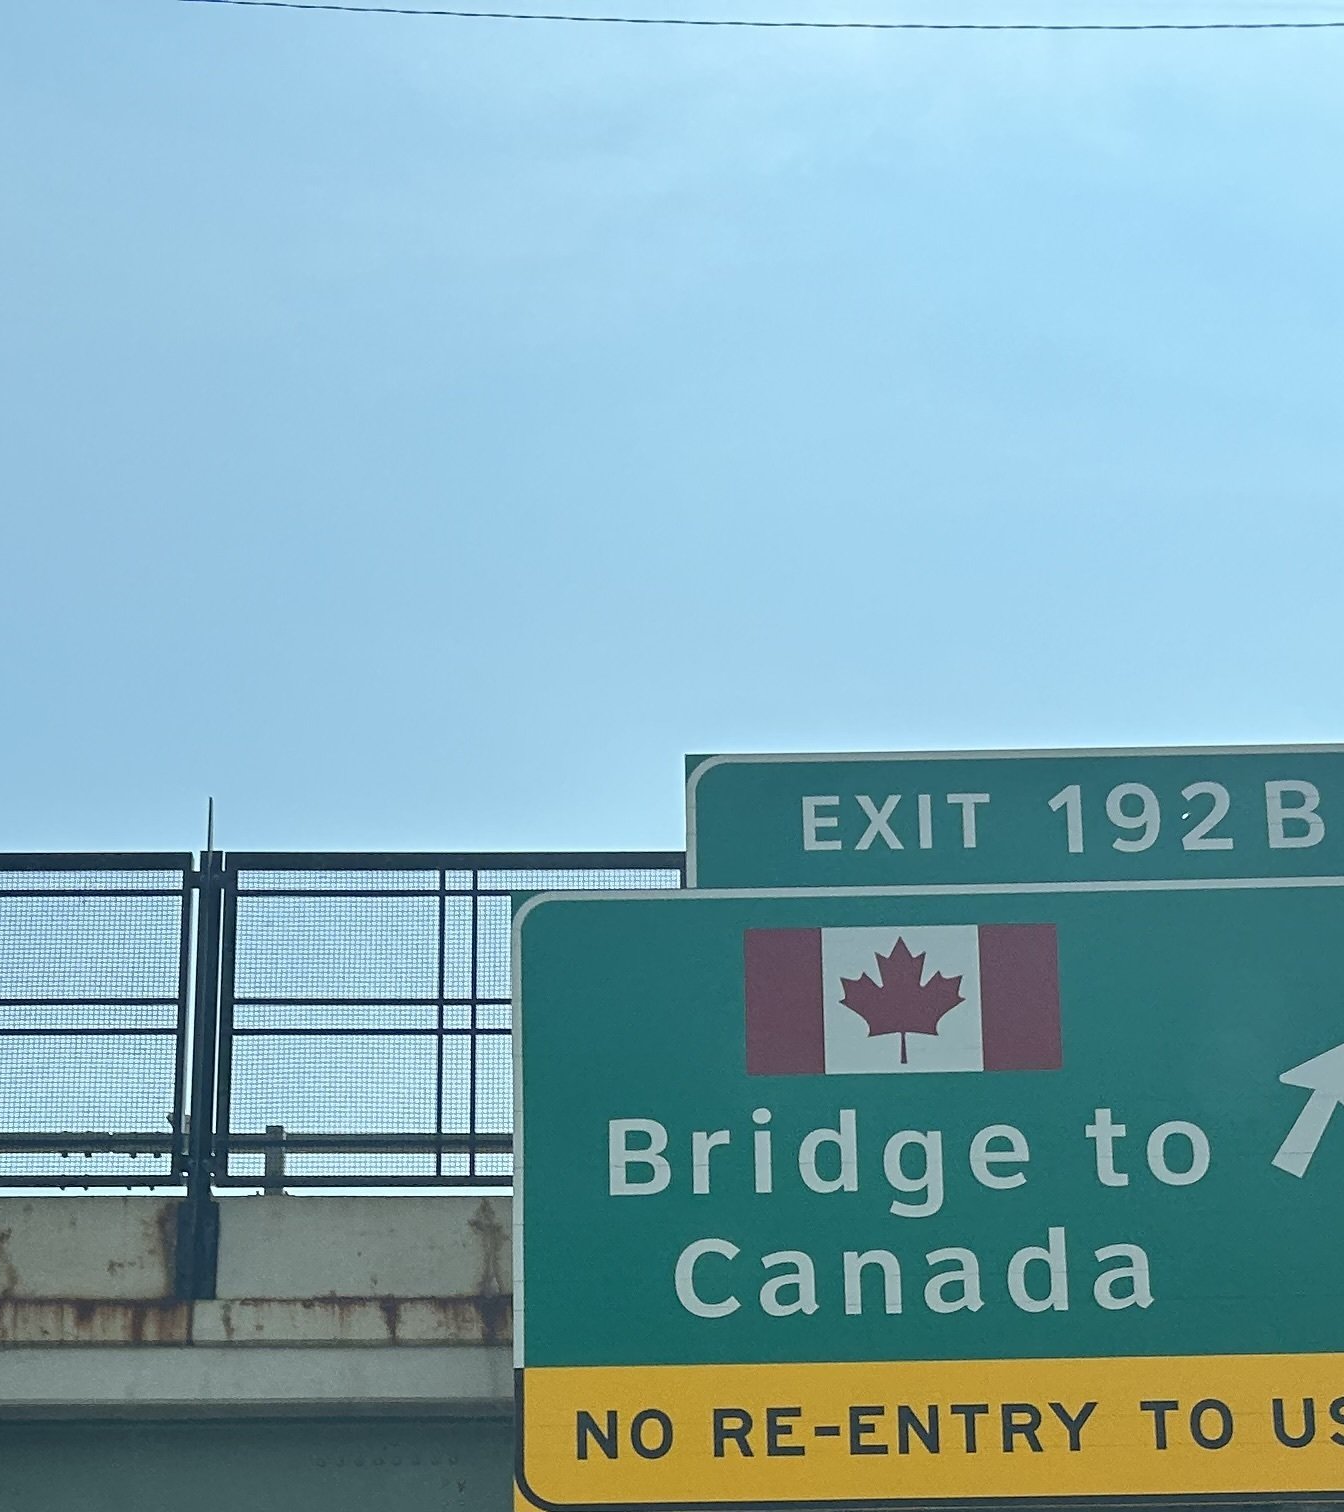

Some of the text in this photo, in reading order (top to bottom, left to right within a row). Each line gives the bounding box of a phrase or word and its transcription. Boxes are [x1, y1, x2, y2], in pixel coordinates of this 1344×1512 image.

[802, 793, 991, 851] EXIT
[608, 1107, 1212, 1218] Bridge to
[674, 1226, 1155, 1318] Canada
[576, 1408, 674, 1461] NO
[712, 1401, 1099, 1458] RE-ENTRY
[1139, 1398, 1235, 1451] TO
